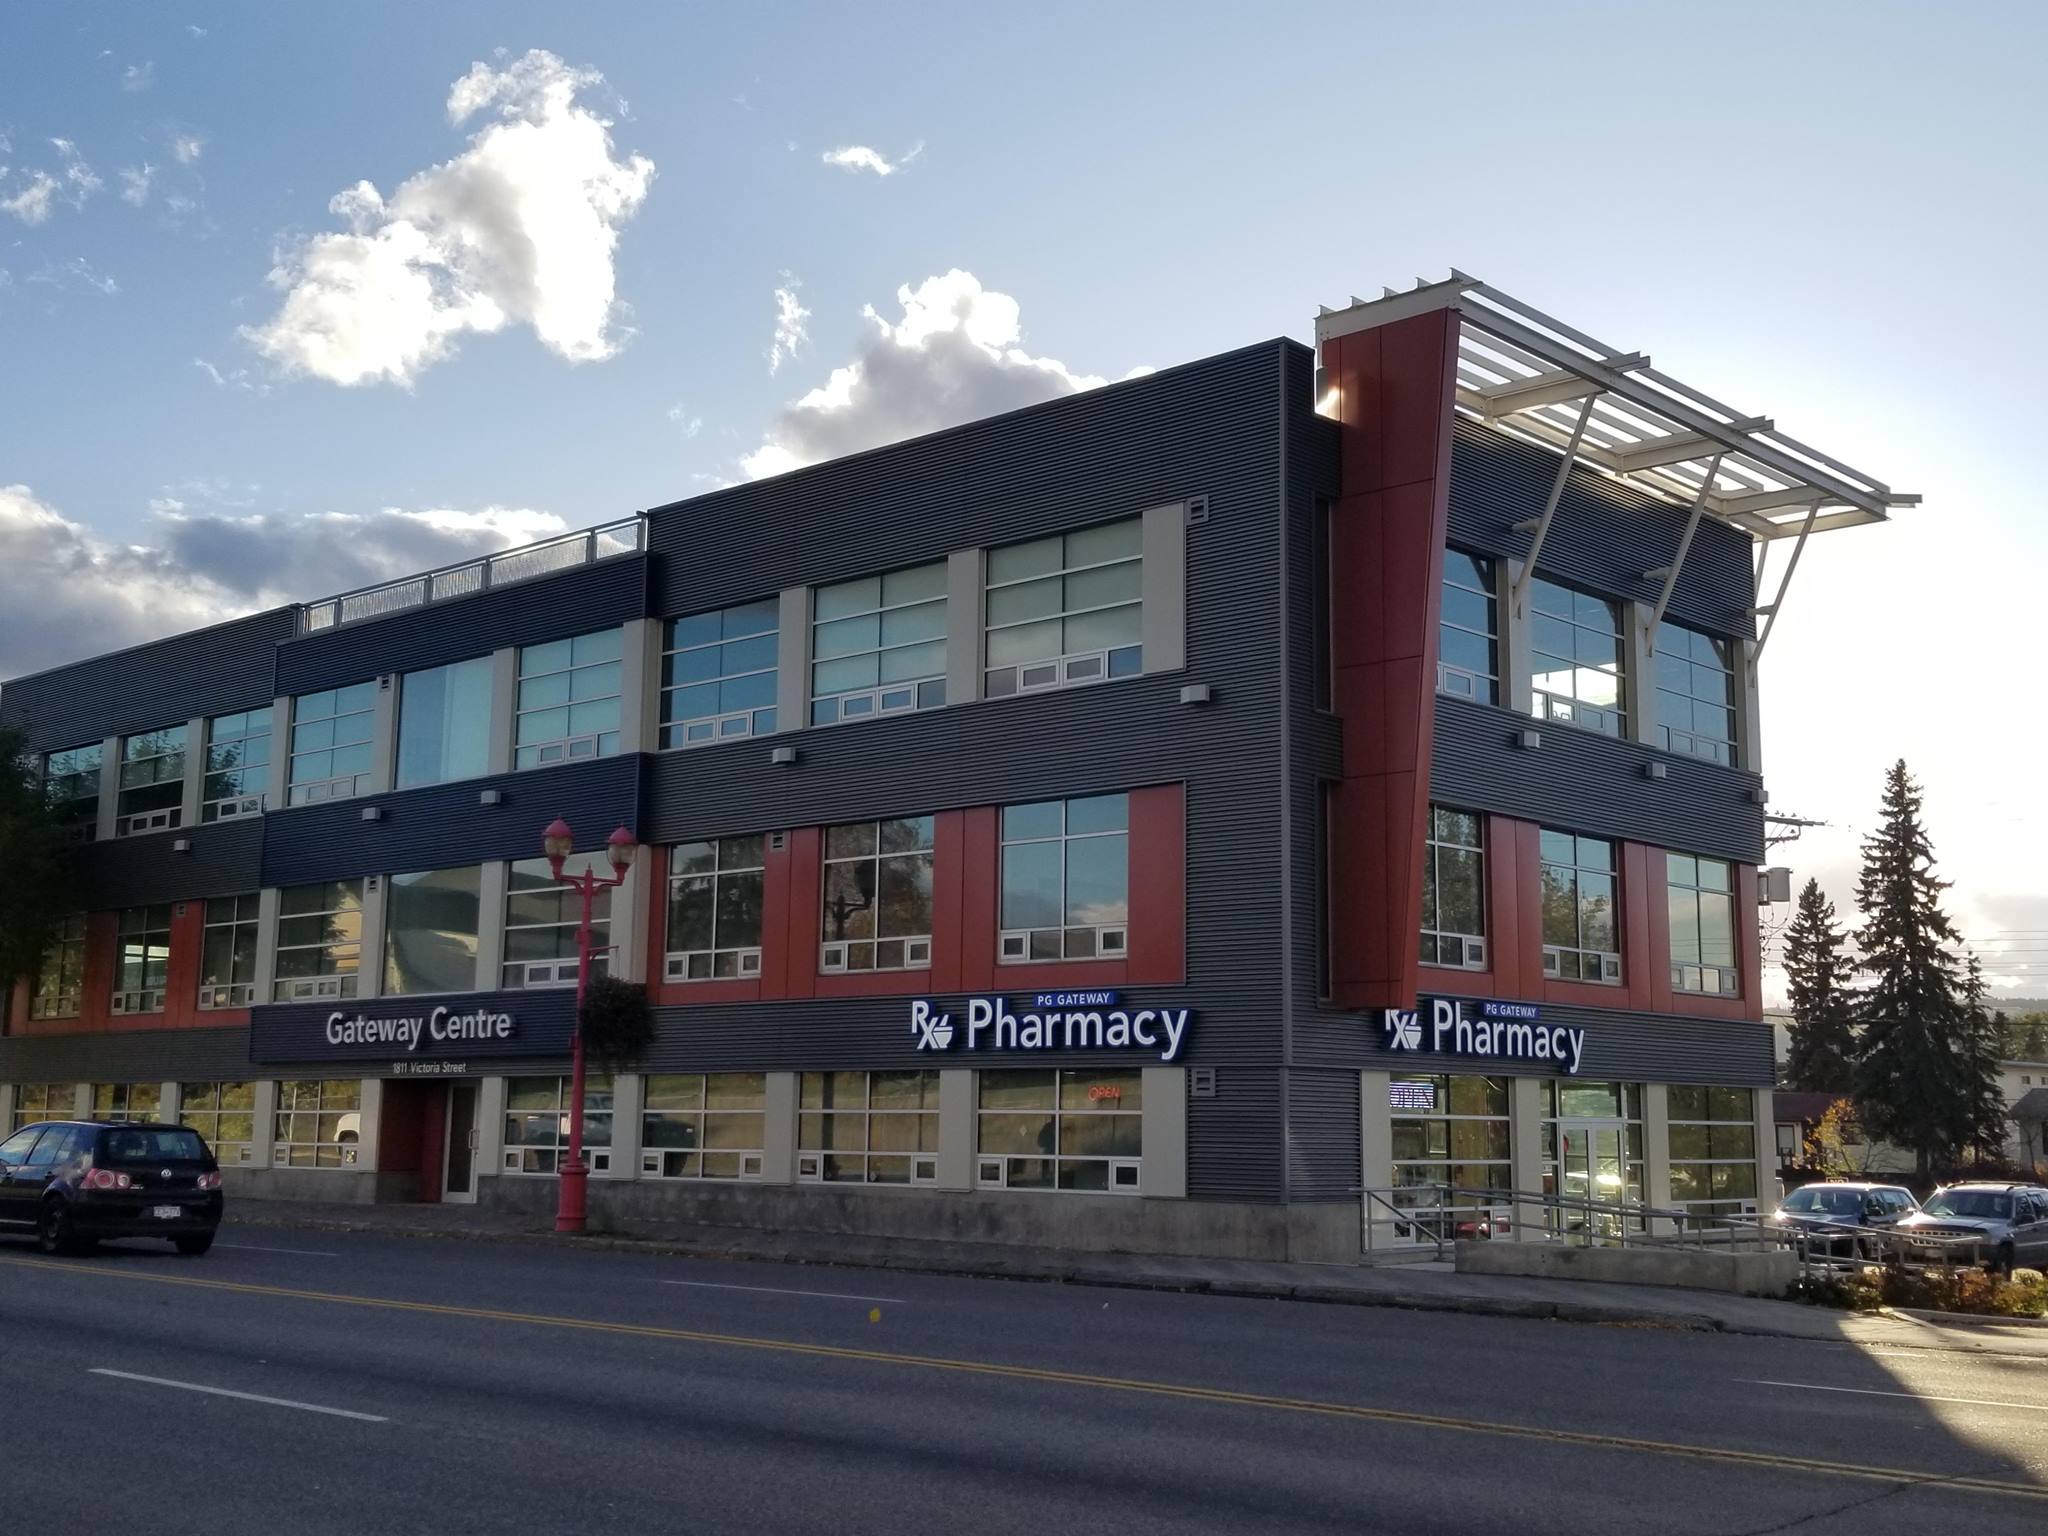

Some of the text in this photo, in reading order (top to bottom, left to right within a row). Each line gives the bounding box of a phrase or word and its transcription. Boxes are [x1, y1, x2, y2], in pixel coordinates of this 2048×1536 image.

[1038, 992, 1110, 1006] PG GATEWAY
[1486, 1003, 1536, 1017] PG GATEWAY
[326, 1006, 511, 1051] Gateway Centre
[968, 998, 1188, 1060] Pharmacy
[1434, 1000, 1584, 1074] Pharmacy
[393, 1061, 467, 1074] 1811 Victoria Street
[1088, 1086, 1120, 1101] OPEN
